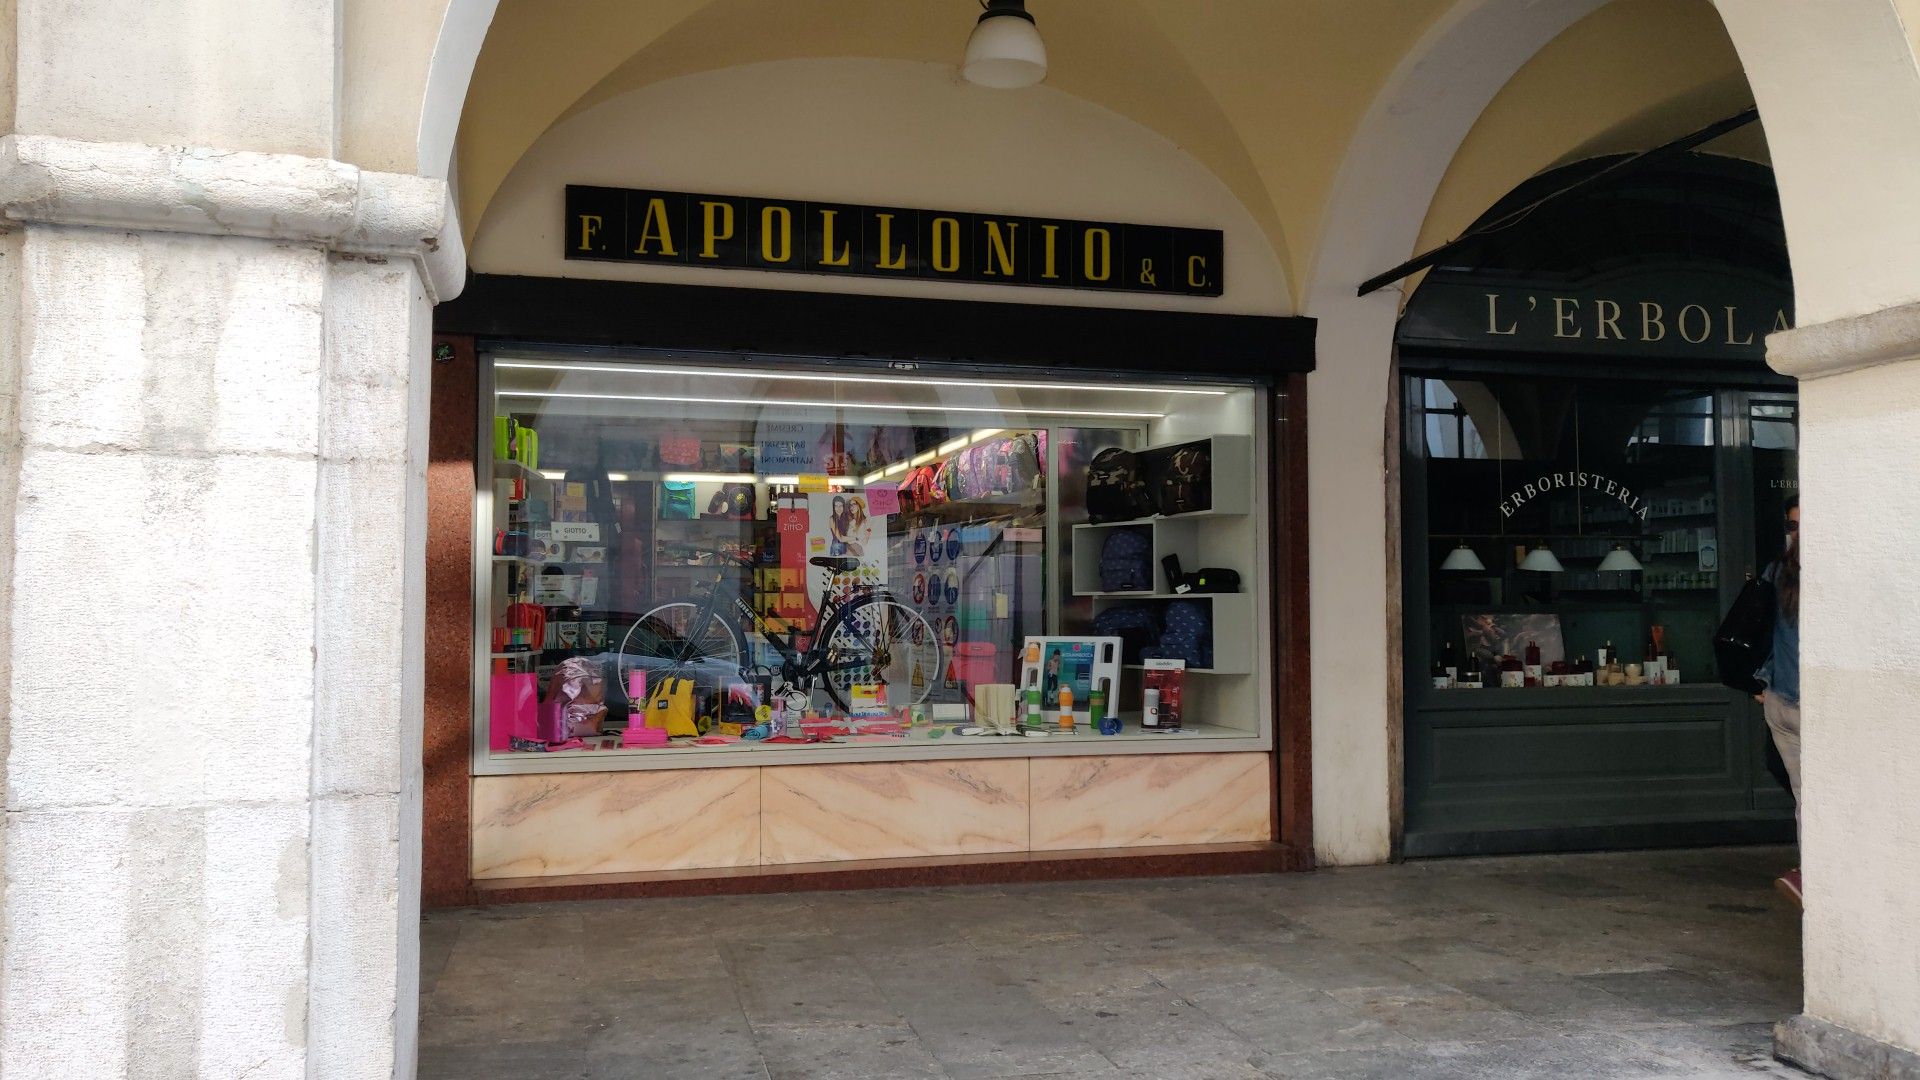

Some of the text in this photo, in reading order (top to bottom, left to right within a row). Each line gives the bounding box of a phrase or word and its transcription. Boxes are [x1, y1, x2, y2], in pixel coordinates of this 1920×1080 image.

[578, 198, 1212, 287] F. APOLLONIO & C.
[1499, 471, 1649, 521] ERBORISTERIA
